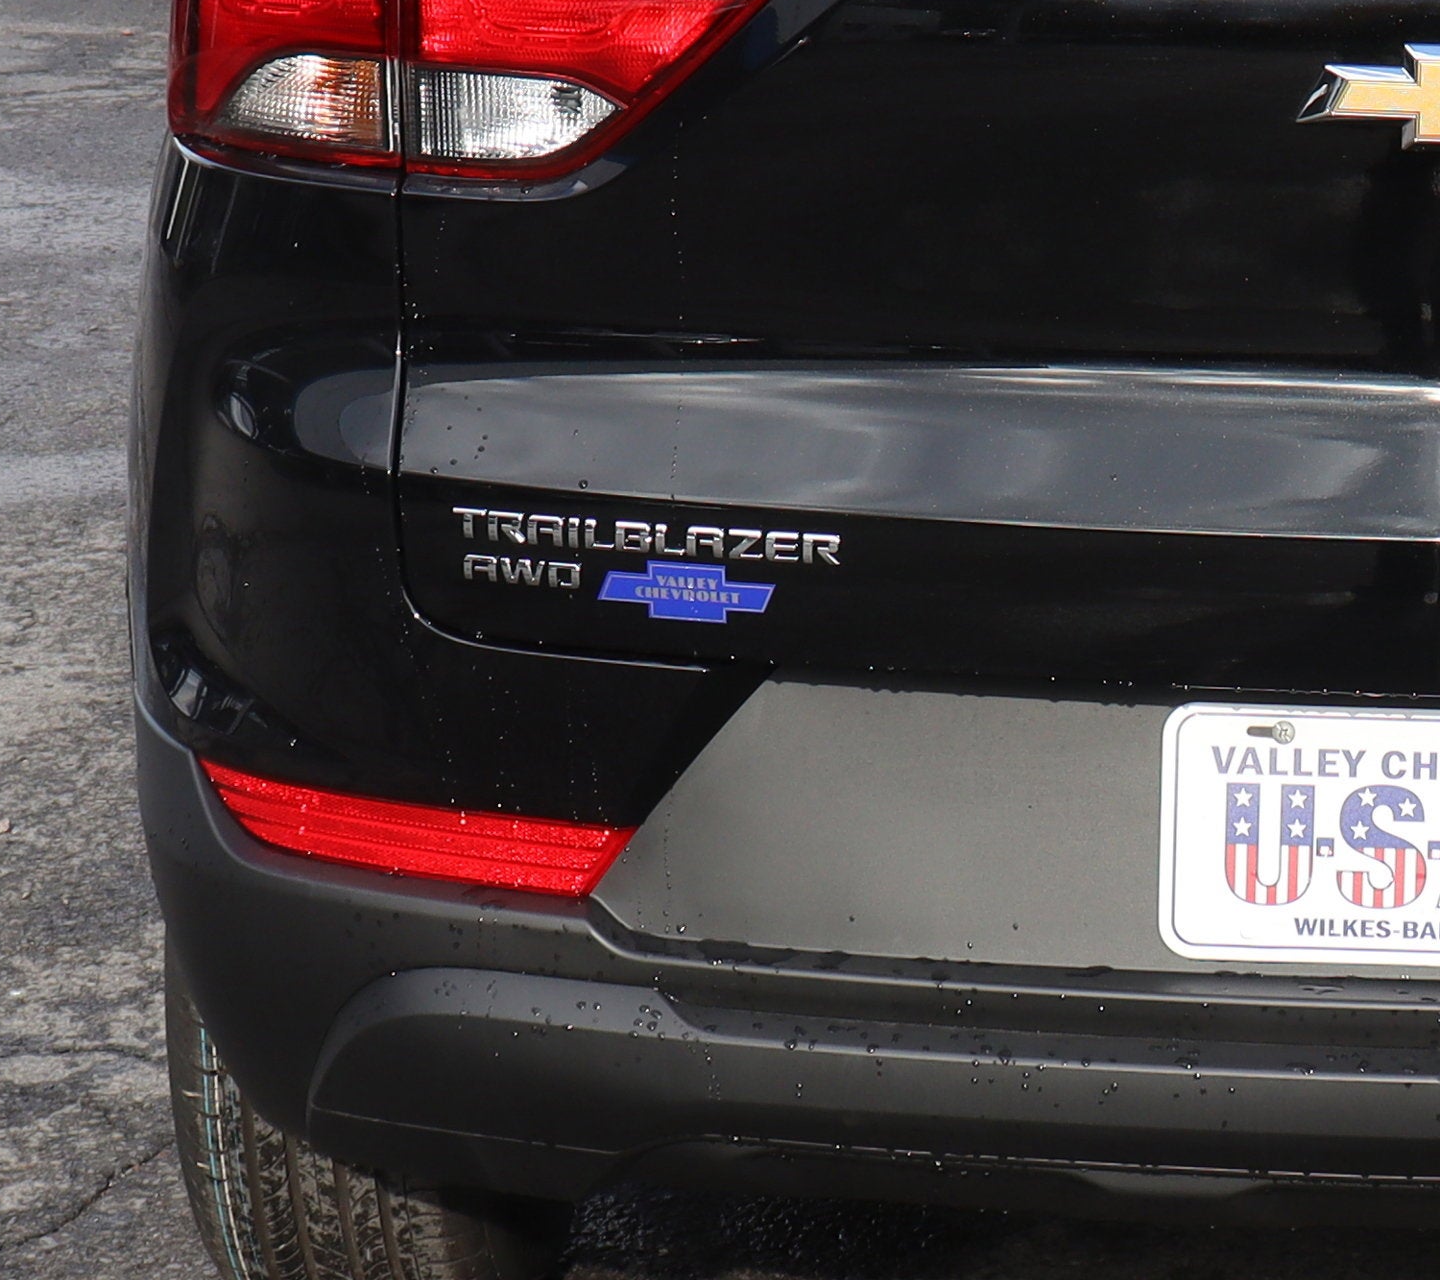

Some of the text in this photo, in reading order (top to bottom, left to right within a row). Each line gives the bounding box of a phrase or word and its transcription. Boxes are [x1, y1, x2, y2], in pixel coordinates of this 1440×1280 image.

[452, 506, 842, 567] TRAILBLAZER
[463, 553, 582, 590] AWD
[655, 574, 719, 591] VALLEY
[634, 585, 741, 606] CHEVROLET
[1212, 746, 1366, 779] VALLEY
